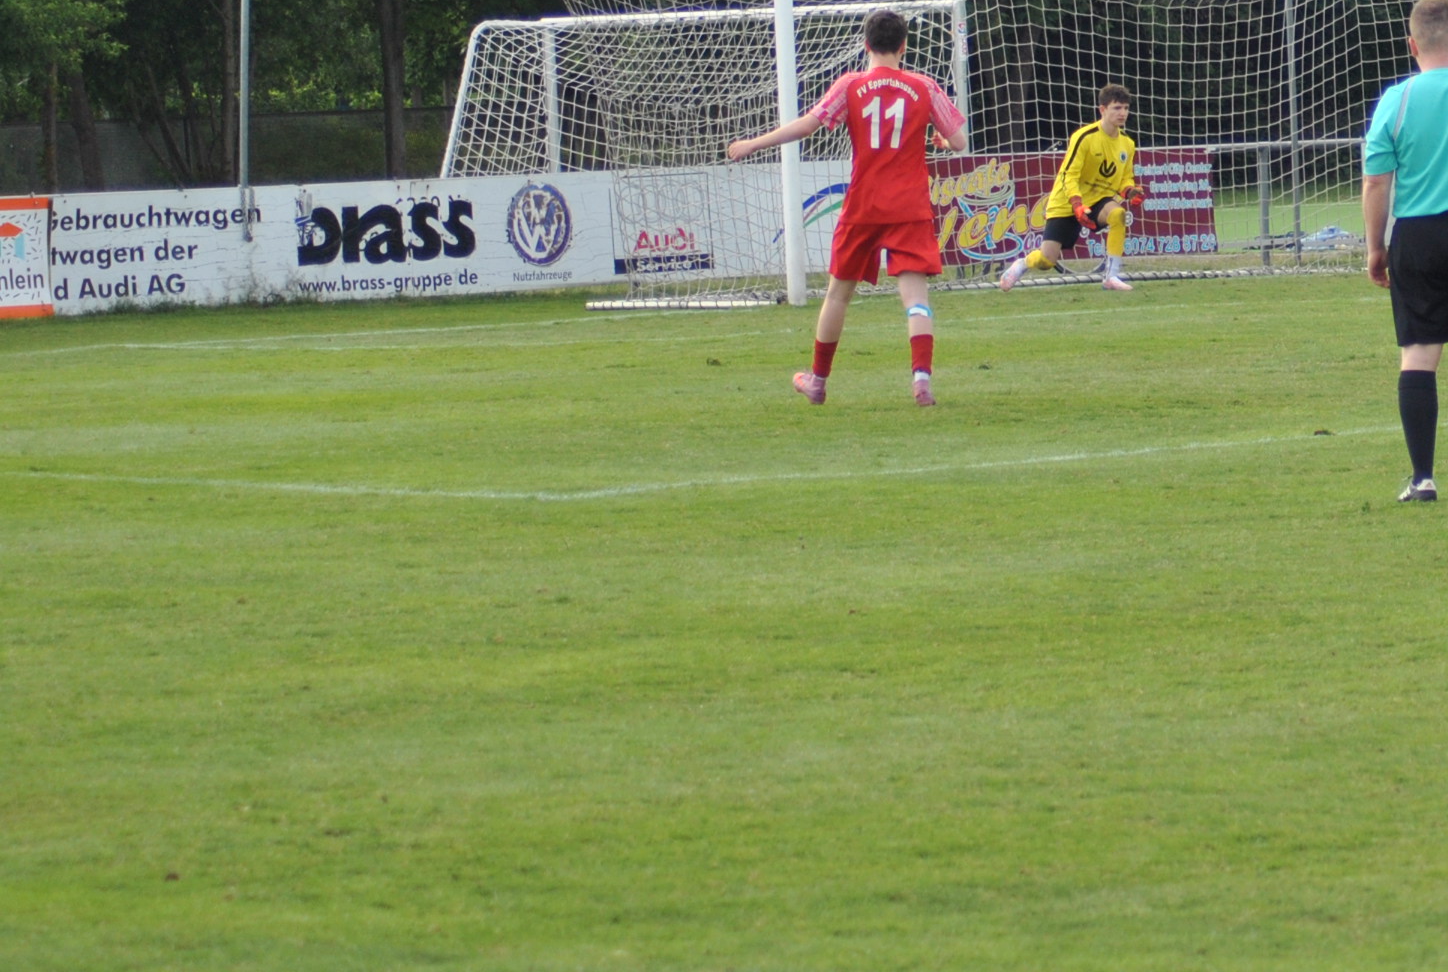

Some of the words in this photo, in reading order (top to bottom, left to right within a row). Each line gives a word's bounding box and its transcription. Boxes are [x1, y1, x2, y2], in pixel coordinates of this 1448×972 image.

[856, 85, 868, 98] FV
[862, 96, 905, 149] 11
[297, 196, 477, 267] brass
[51, 245, 145, 270] twagen
[154, 239, 199, 261] der
[53, 278, 69, 301] d
[79, 274, 139, 299] Audi
[147, 273, 186, 296] AG
[513, 269, 573, 283] Nutzfahrzeuge
